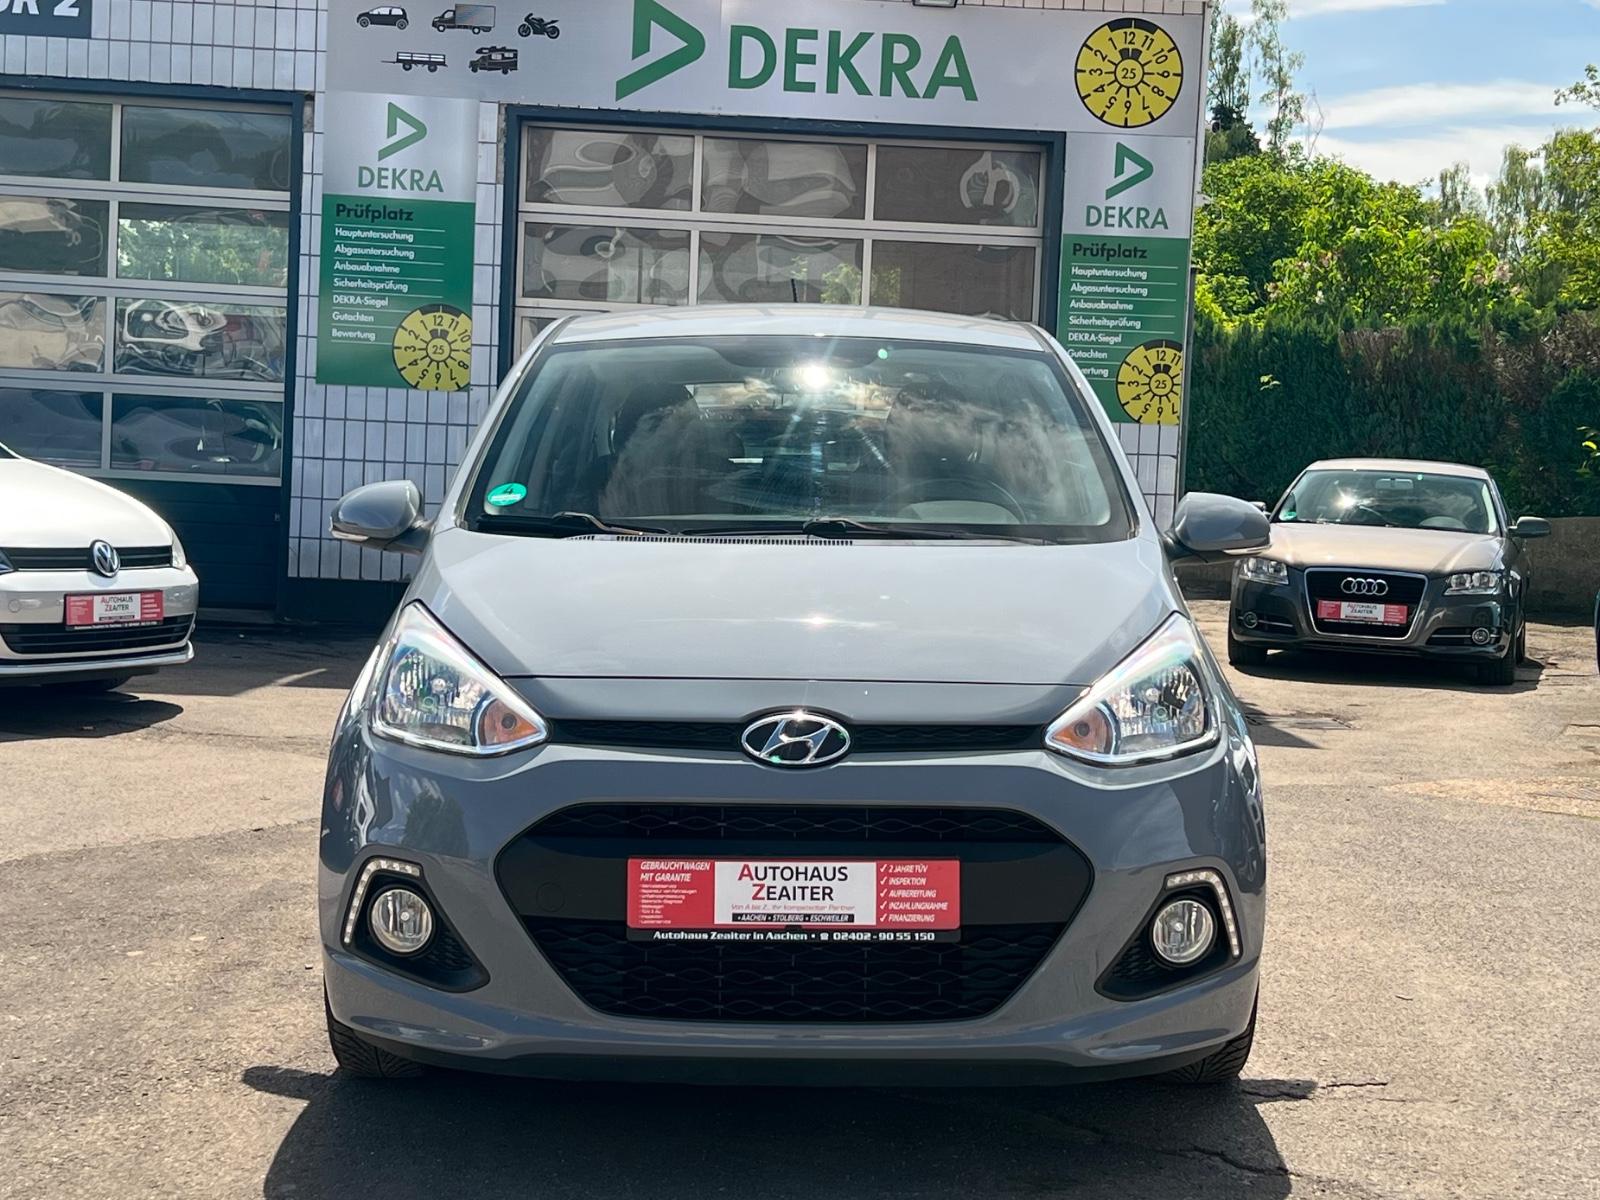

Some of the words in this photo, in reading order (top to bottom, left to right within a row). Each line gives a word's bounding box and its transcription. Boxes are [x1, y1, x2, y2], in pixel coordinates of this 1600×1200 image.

[1122, 31, 1136, 45] 12
[1141, 35, 1155, 51] 11
[1094, 49, 1108, 62] 2
[1152, 48, 1168, 64] 10
[728, 25, 979, 102] DEKRA
[1089, 68, 1103, 76] 3
[1121, 67, 1137, 80] 25
[1092, 84, 1105, 92] 4
[1151, 86, 1165, 97] 8
[1105, 96, 1117, 109] 5
[358, 165, 444, 192] DEKRA
[335, 203, 414, 223] Prüfplatz
[1085, 205, 1168, 230] DEKRA
[335, 227, 414, 242] Hauptuntersuchung
[334, 244, 415, 260] Abgasuntersuchung
[1072, 242, 1148, 261] Prüfplatz
[333, 261, 400, 274] Anbauabnahme
[1071, 266, 1148, 280] Hauptuntersuchung
[333, 277, 408, 293] Sicherheitsprüfung
[1070, 283, 1148, 297] Abgasuntersuchung
[332, 294, 389, 308] DEKRA-Siegel
[1069, 299, 1134, 310] Anbauabnahme
[332, 311, 374, 323] Gutachten
[432, 314, 444, 327] 12
[1069, 315, 1141, 329] Sicherheitsprüfung
[448, 318, 459, 331] 11
[331, 328, 376, 341] Bewertung
[408, 329, 420, 340] 2
[1068, 332, 1122, 345] DEKRA-Siegel
[404, 345, 416, 353] 3
[432, 344, 445, 355] 25
[1067, 348, 1108, 359] Gutachten
[1155, 350, 1167, 361] 12
[1170, 352, 1181, 366] 11
[457, 360, 469, 370] 8
[1132, 365, 1143, 375] 2
[419, 368, 429, 380] 5
[1081, 367, 1109, 378] ertung
[1127, 380, 1139, 388] 3
[1154, 380, 1167, 389] 25
[1141, 403, 1151, 414] 5
[640, 861, 711, 871] GEBRAUCHTWAGEN
[888, 864, 894, 873] 2
[894, 864, 914, 873] JAHRE
[914, 863, 929, 873] TÜV
[640, 873, 654, 882] MIT
[654, 873, 692, 882] GARANTIE
[737, 863, 849, 882] AUTOHAUS
[888, 876, 927, 886] INSPEKTION
[751, 883, 835, 901] ZEAITER
[888, 889, 937, 898] AUFBEREITUNG
[888, 901, 949, 911] INZAHLUNGNAHME
[740, 913, 767, 922] AACHEN
[772, 914, 804, 922] STOLBERG
[810, 914, 849, 923] ESCHWEILER
[888, 913, 935, 922] FINANZIERUNG
[653, 930, 709, 940] Autohaus
[710, 931, 752, 940] Zeaiter
[753, 931, 765, 940] in
[765, 931, 808, 940] Aachen
[833, 932, 871, 940] 02402
[895, 932, 911, 940] 55
[914, 932, 936, 941] 150
